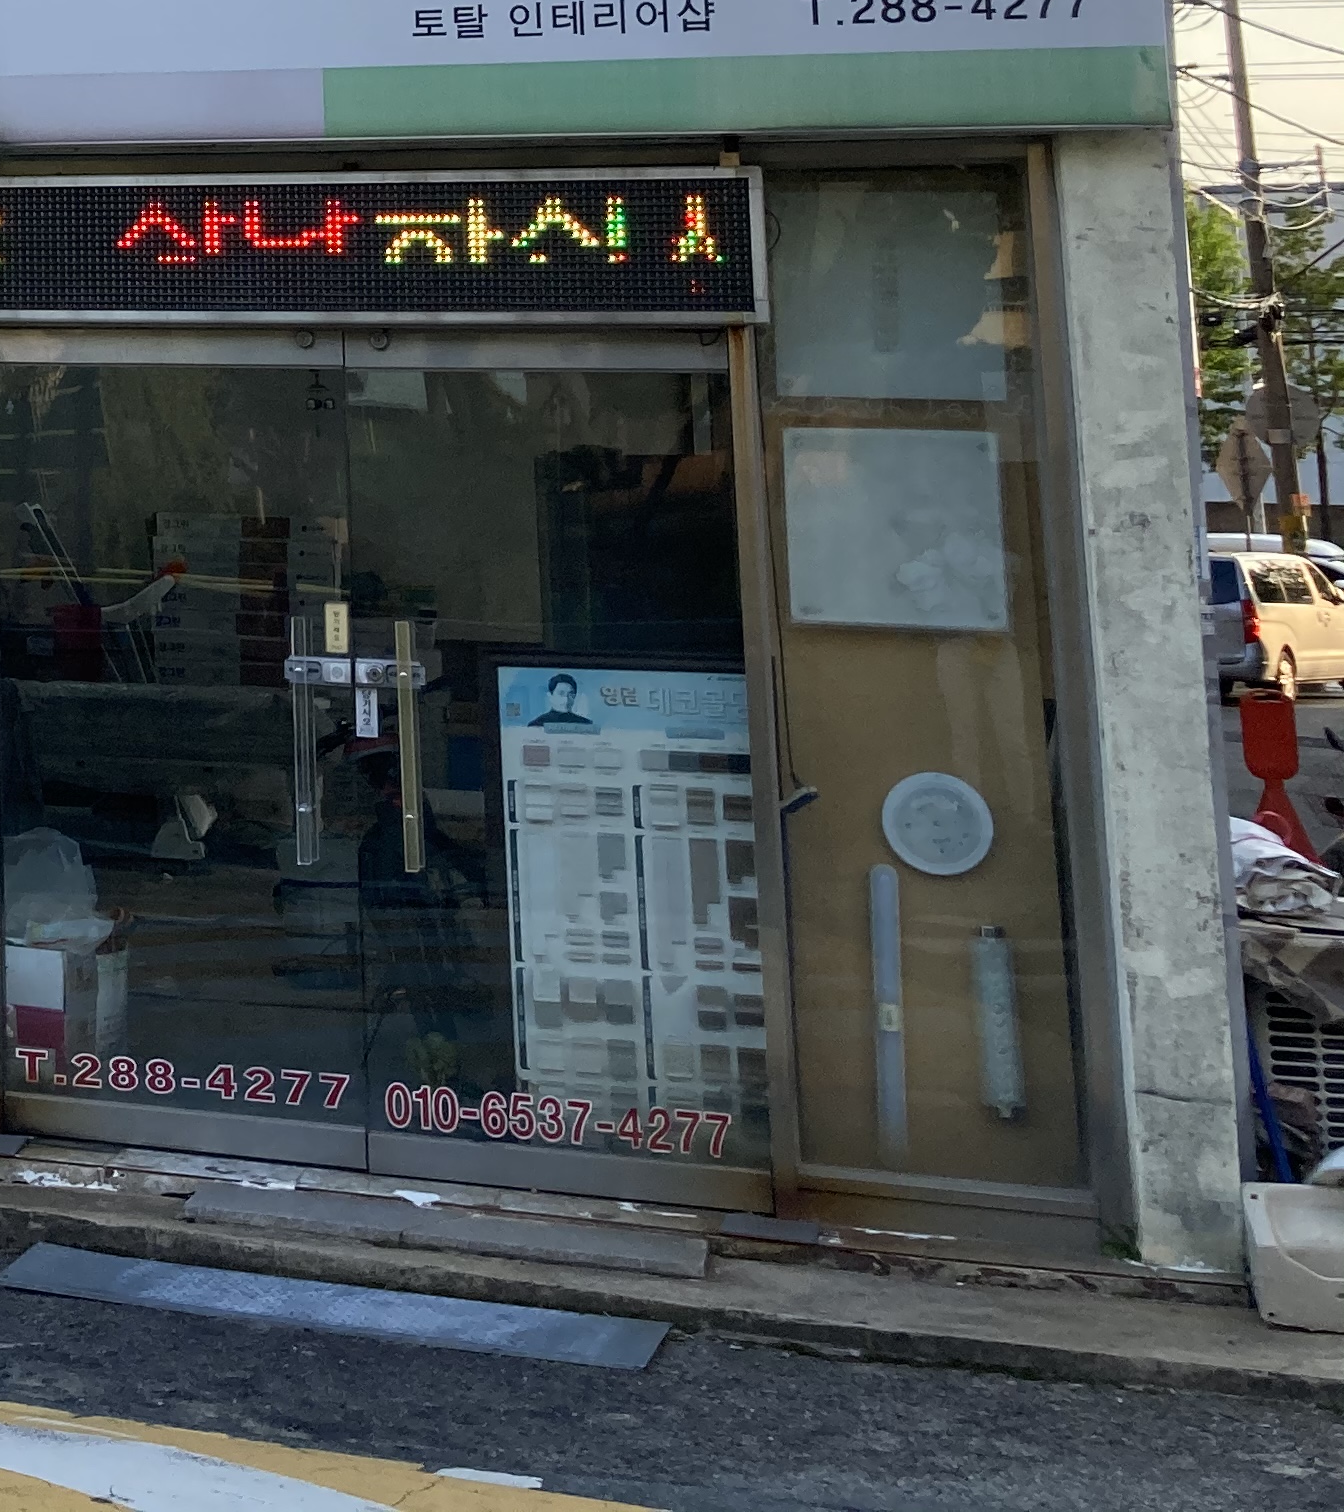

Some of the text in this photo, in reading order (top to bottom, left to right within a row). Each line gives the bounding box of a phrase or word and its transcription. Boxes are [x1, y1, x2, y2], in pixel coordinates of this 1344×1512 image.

[412, 3, 489, 40] 토탈
[15, 1047, 350, 1109] T.288-4277
[384, 1081, 731, 1158] 010-6537-4277
